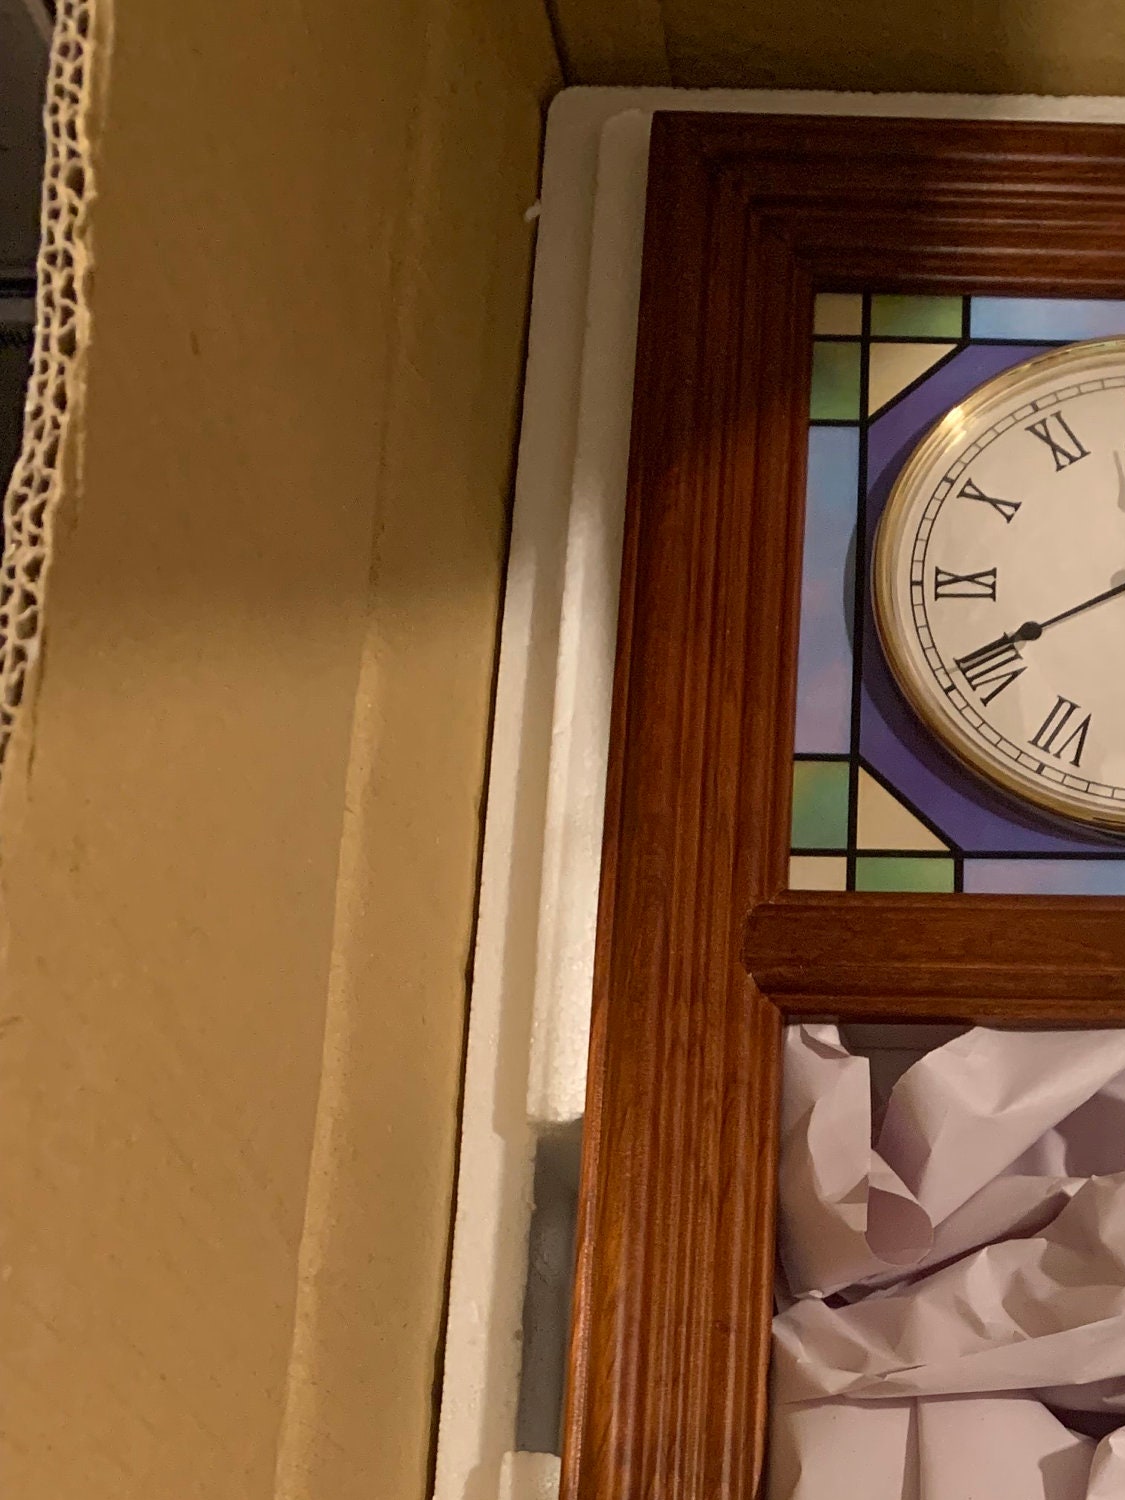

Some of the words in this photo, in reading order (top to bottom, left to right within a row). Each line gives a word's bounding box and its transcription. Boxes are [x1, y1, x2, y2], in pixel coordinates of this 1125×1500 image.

[1025, 411, 1091, 472] XI
[957, 478, 1022, 523] X
[935, 567, 998, 602] IX
[954, 632, 1028, 706] VIII
[1028, 695, 1092, 768] VII
